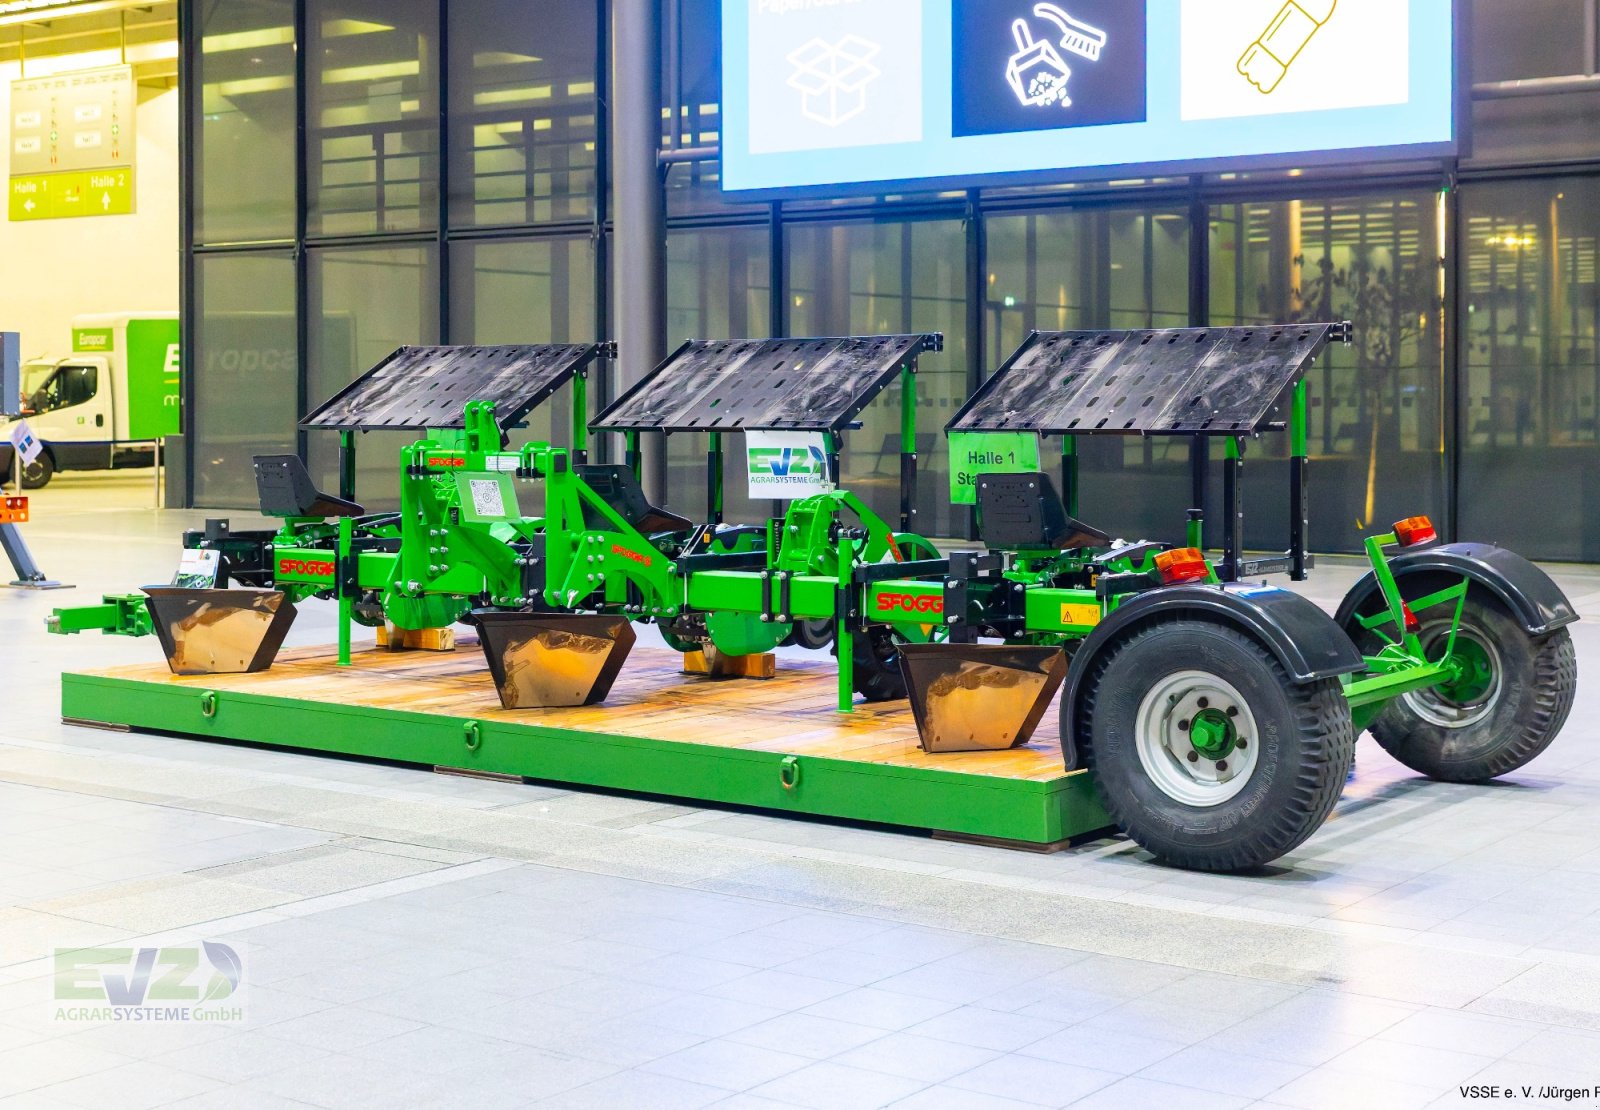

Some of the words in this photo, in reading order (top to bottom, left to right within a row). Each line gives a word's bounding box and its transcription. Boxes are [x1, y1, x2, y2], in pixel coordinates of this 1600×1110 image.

[14, 181, 36, 193] Halle
[42, 180, 47, 192] 1
[91, 175, 115, 188] Halle
[118, 173, 125, 187] 2
[79, 333, 107, 345] Europcar
[748, 447, 811, 476] EVZ
[968, 451, 1003, 465] Halle
[1008, 451, 1015, 465] 1
[750, 476, 808, 484] AGRARSYSTEME
[808, 476, 828, 484] GmH
[957, 472, 977, 486] Sta
[877, 592, 944, 614] SFOGG
